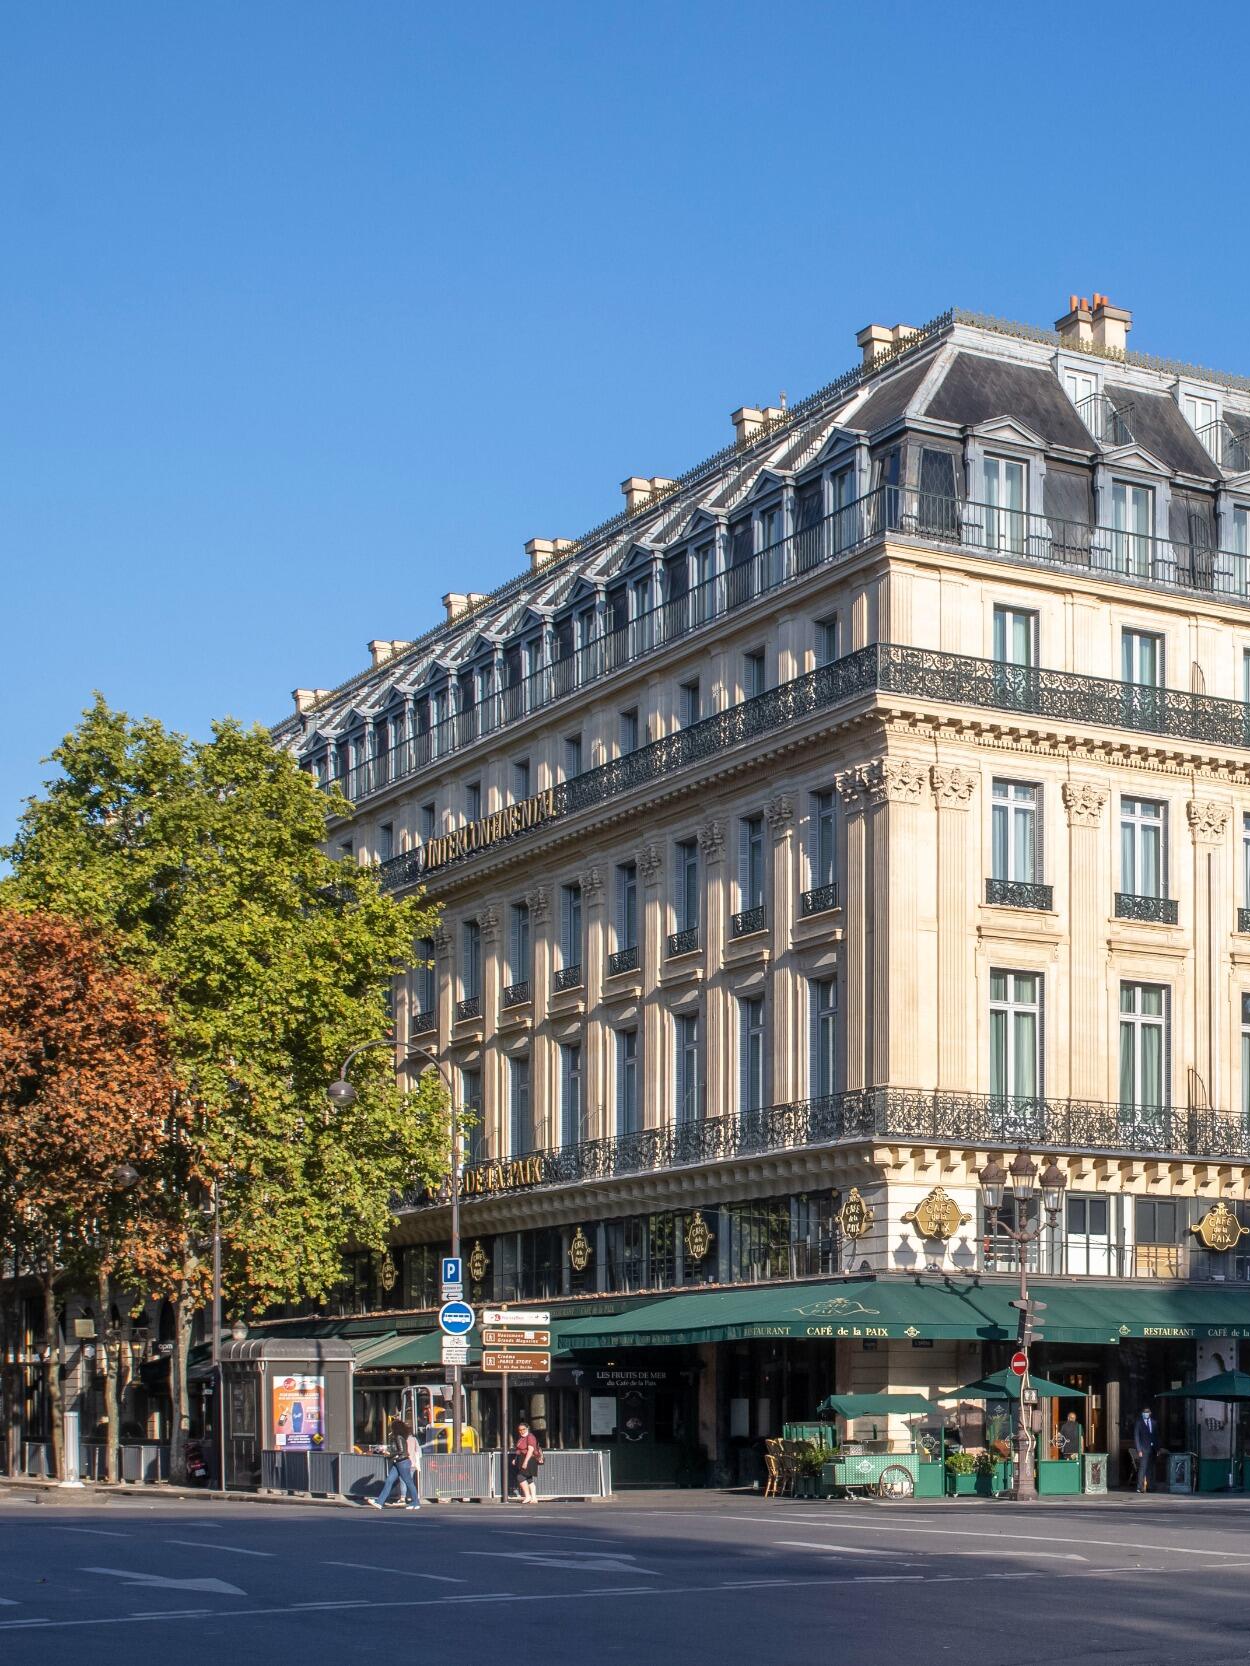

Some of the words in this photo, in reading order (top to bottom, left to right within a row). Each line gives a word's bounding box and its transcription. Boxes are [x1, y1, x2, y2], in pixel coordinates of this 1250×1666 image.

[428, 786, 557, 868] INTERCONTINENTAL
[509, 1157, 542, 1187] PAIX
[1211, 1233, 1231, 1243] PAIX
[447, 1263, 456, 1279] P
[806, 1325, 833, 1336] CAFÉ
[837, 1326, 849, 1336] de
[853, 1326, 861, 1336] la
[865, 1327, 889, 1337] PAIX
[1143, 1327, 1196, 1336] RESTAURANT
[1231, 1328, 1240, 1337] de
[1243, 1328, 1250, 1337] la
[596, 1371, 610, 1379] LES
[611, 1371, 638, 1379] FRUITS
[639, 1371, 649, 1379] DE
[650, 1371, 667, 1379] MER
